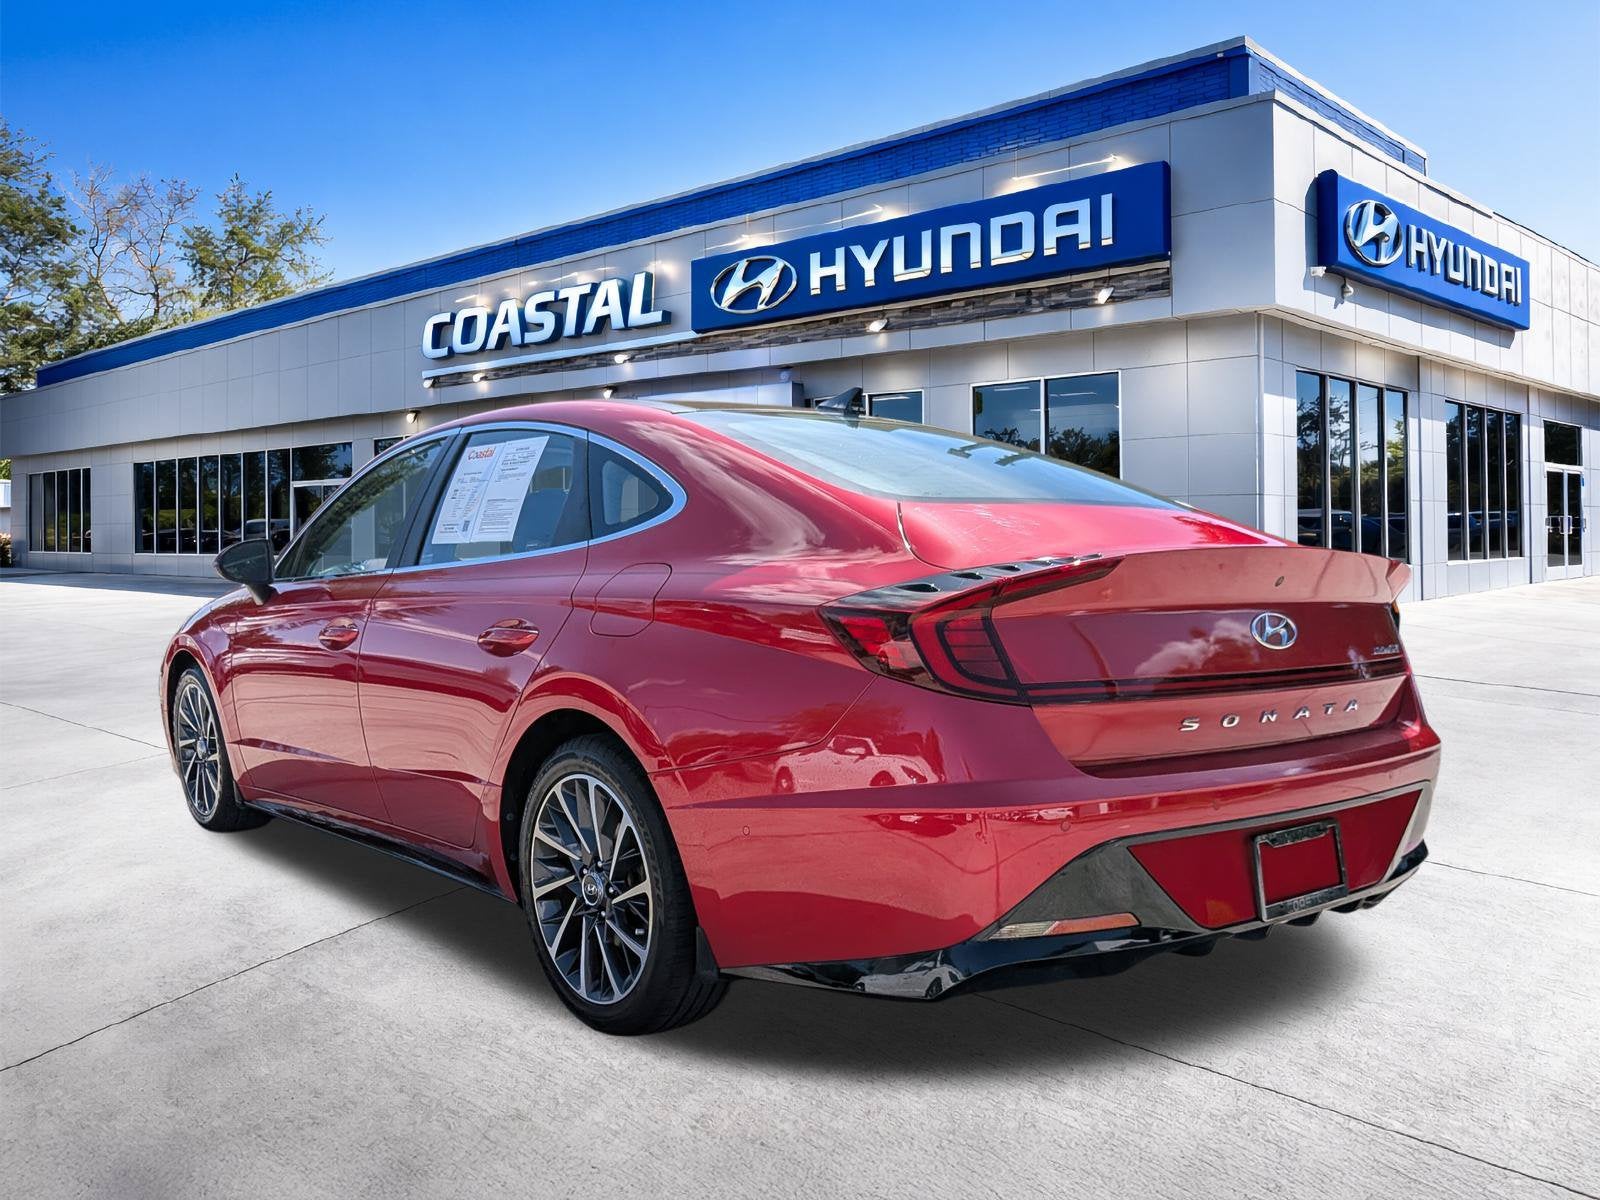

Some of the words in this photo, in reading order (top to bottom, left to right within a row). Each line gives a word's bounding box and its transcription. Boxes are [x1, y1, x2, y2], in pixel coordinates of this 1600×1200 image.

[809, 193, 1114, 295] HYUNDAI
[1407, 224, 1522, 306] HYUNDAI
[422, 271, 667, 359] COASTAL
[1179, 700, 1359, 732] SONATA
